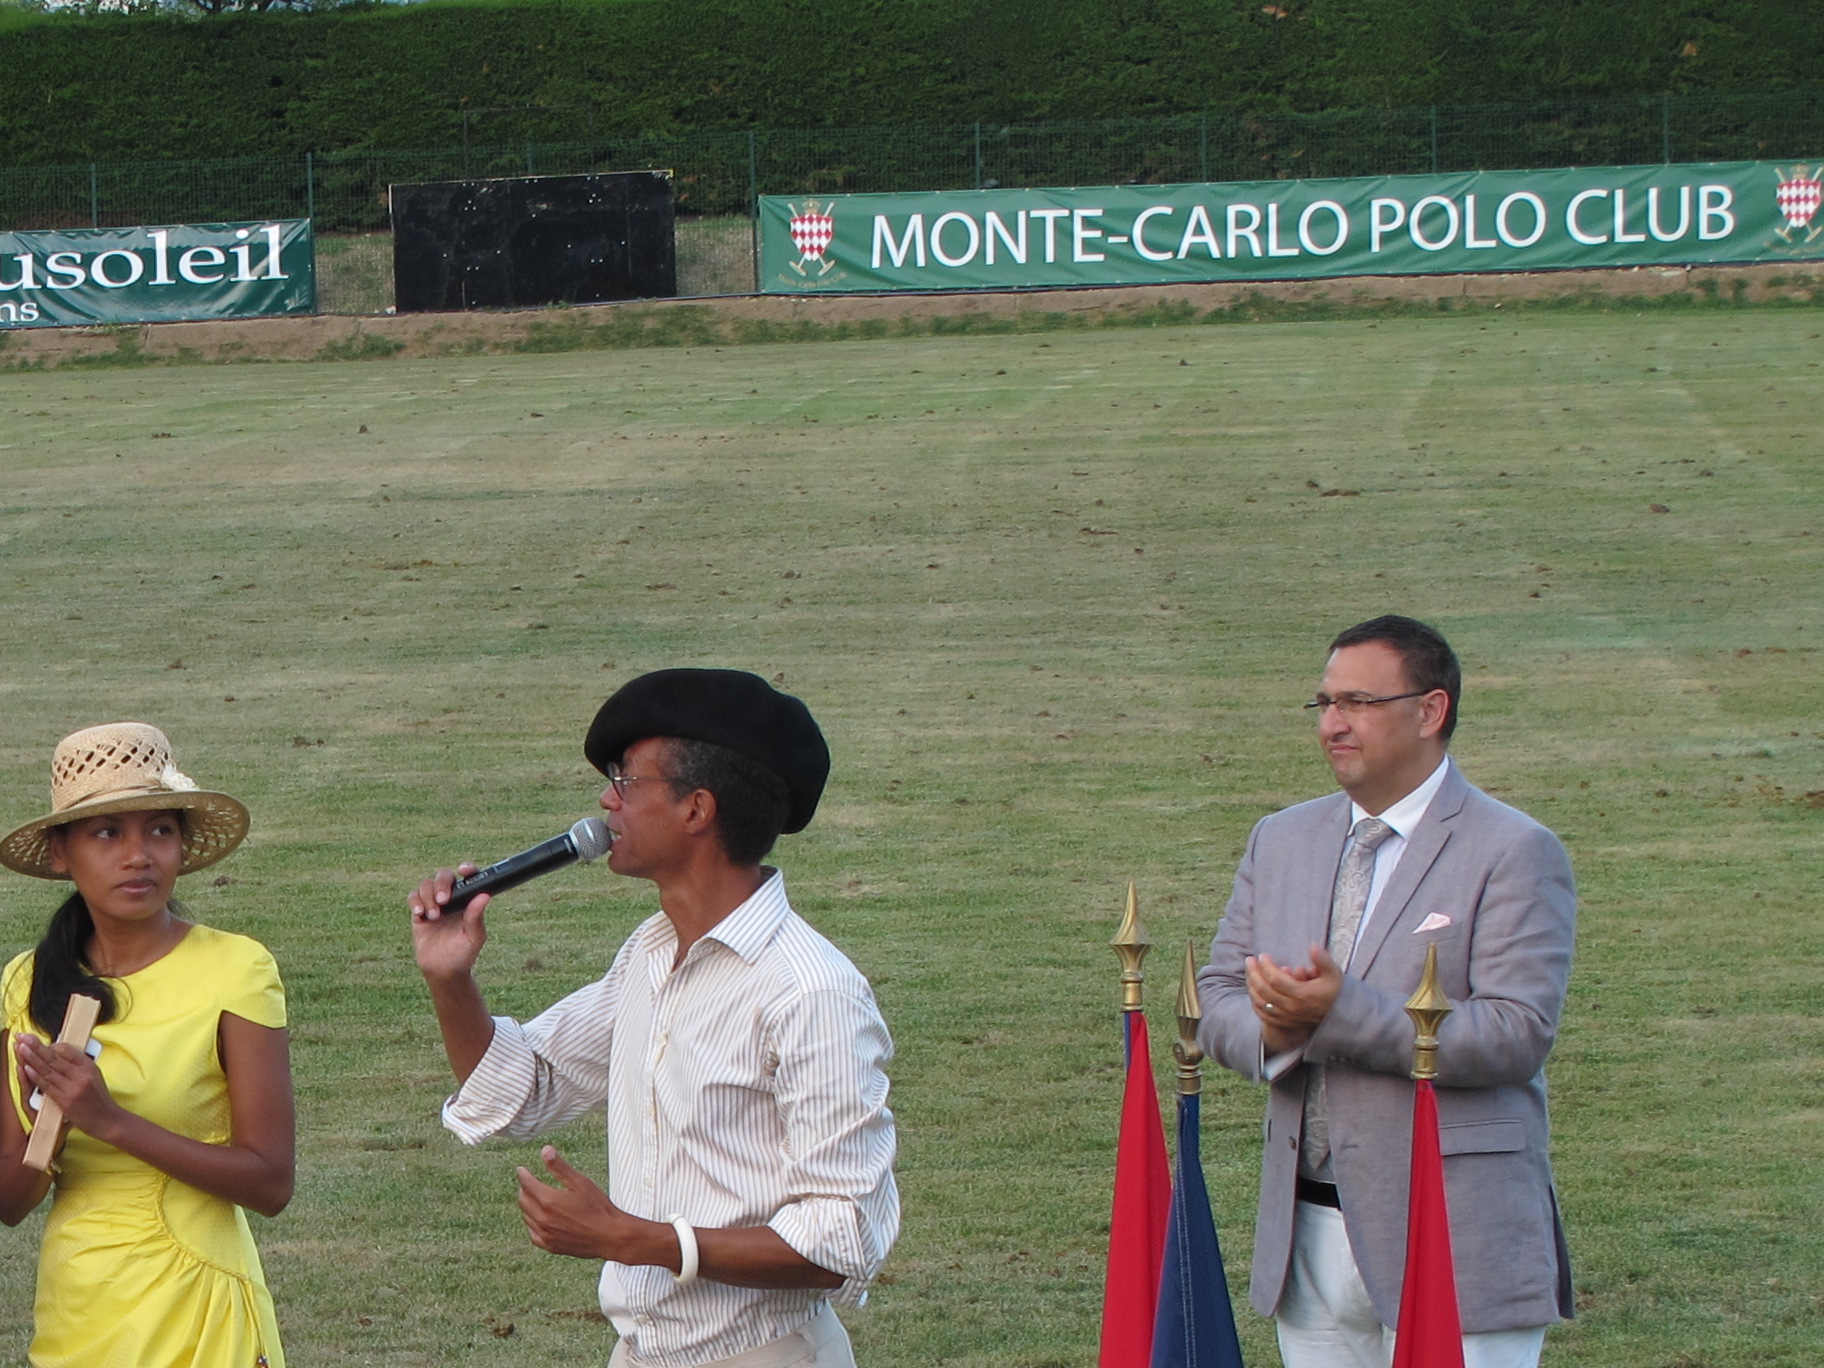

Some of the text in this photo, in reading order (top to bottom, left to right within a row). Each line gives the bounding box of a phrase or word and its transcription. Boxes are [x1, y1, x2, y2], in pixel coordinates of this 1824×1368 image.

[871, 185, 1735, 269] MONTE-CARLO POLO CLUB
